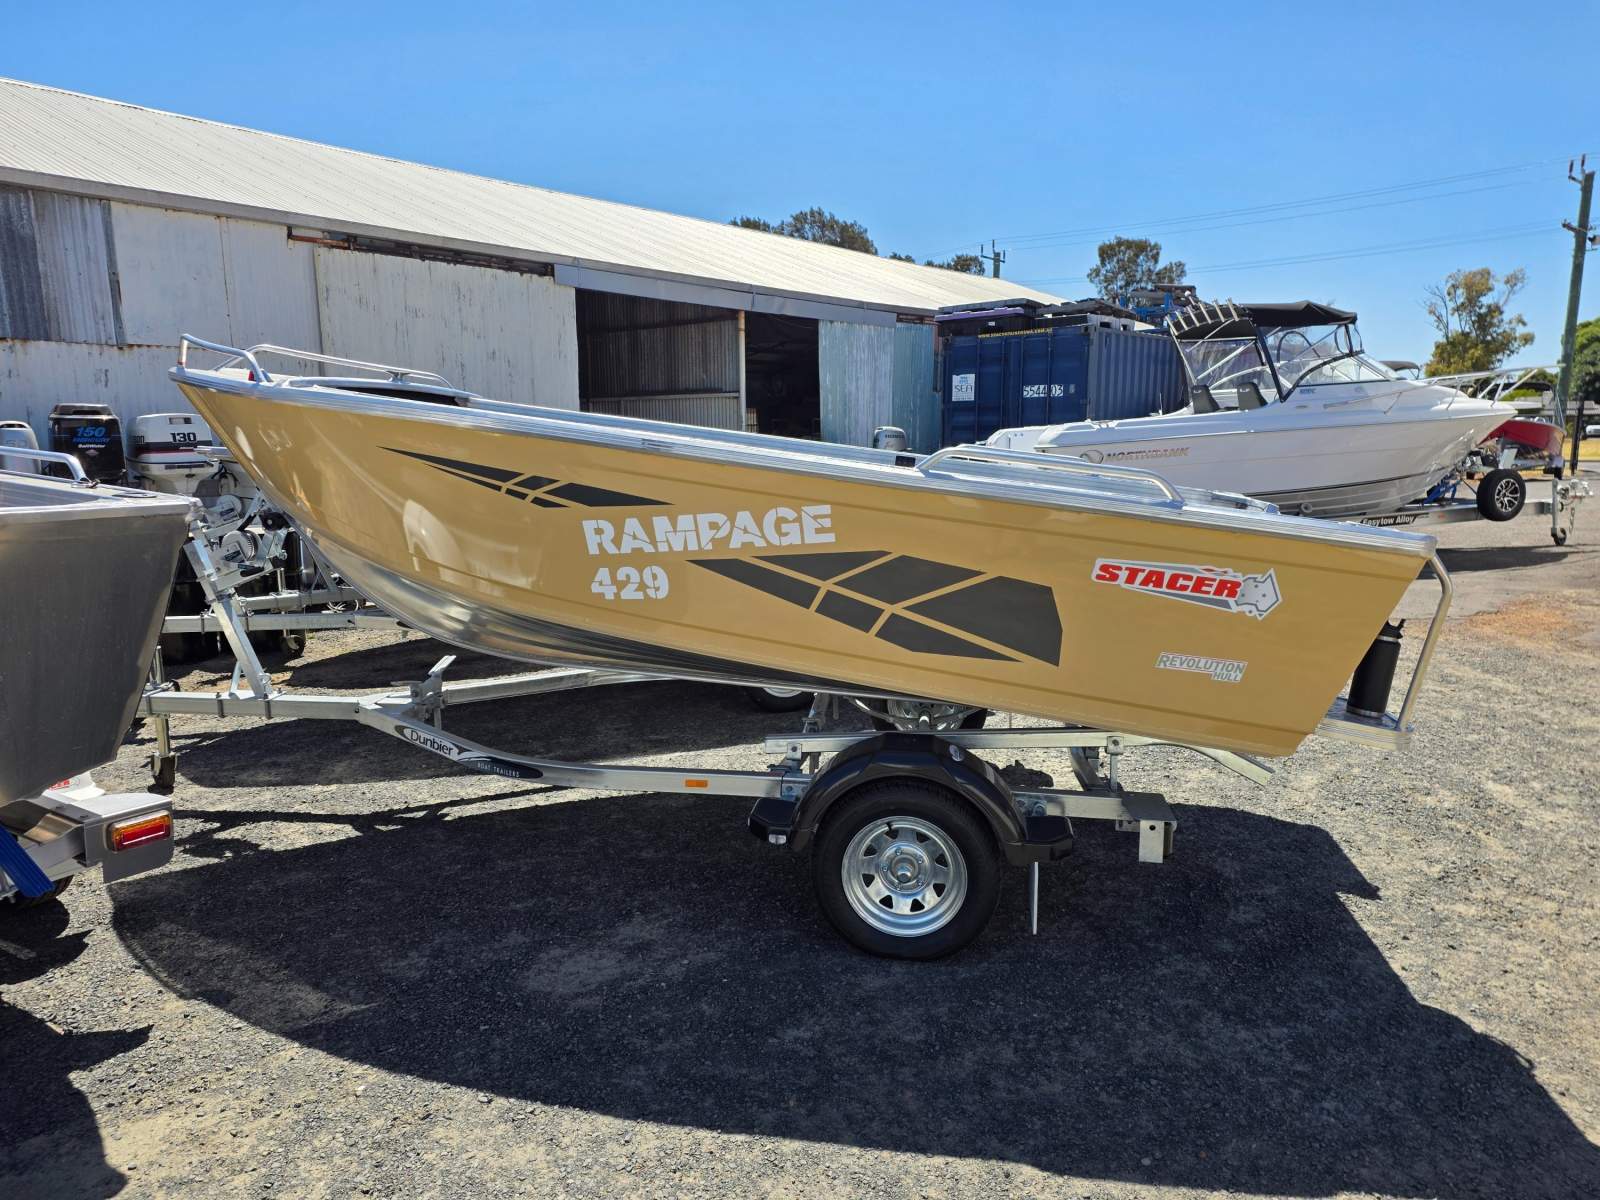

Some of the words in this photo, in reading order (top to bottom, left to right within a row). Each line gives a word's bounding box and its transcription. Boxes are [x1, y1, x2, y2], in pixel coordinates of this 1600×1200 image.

[76, 426, 106, 437] 150
[170, 432, 197, 443] 130
[1396, 514, 1415, 524] Alloy
[582, 504, 836, 555] RAMPAGE
[591, 565, 670, 600] 429
[1095, 563, 1243, 599] STACER
[1157, 654, 1245, 674] REVOLUTION
[1212, 671, 1240, 682] HULL
[410, 729, 454, 755] Dunbier
[477, 762, 491, 771] BOAT
[493, 766, 520, 778] TRAILERS
